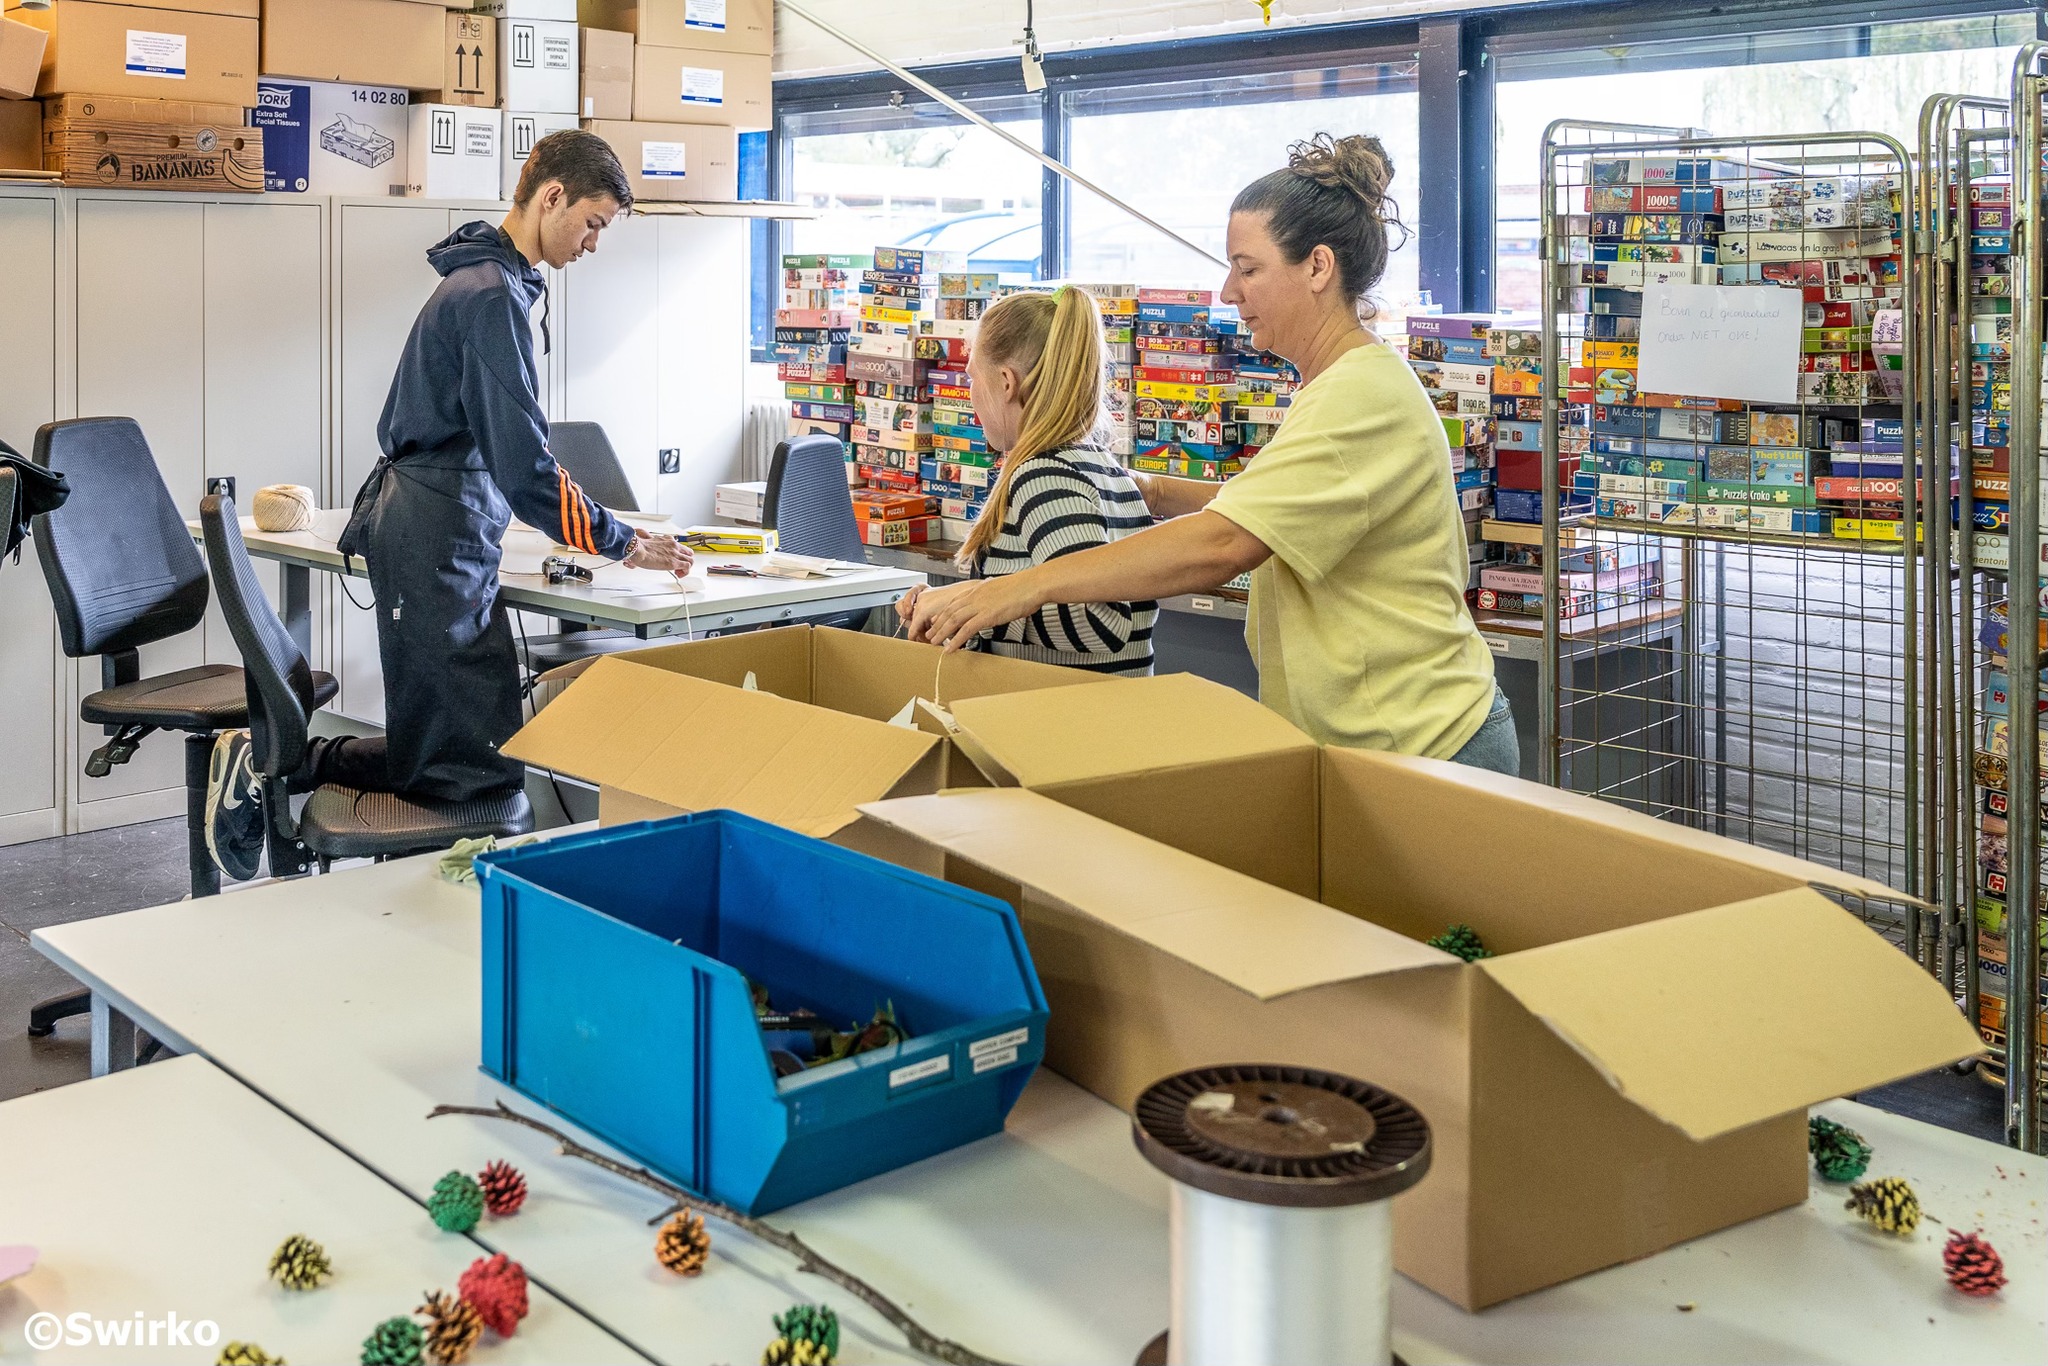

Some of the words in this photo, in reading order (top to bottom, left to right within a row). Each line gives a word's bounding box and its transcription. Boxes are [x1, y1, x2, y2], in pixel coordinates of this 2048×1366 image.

[258, 93, 289, 106] TORK
[352, 90, 367, 102] 14
[371, 91, 386, 104] 02
[391, 93, 406, 105] 80
[256, 110, 273, 118] Extra
[274, 111, 288, 119] Soft
[256, 118, 276, 126] Facial
[276, 119, 300, 127] Tissues
[156, 153, 188, 161] PREMIUM
[132, 159, 215, 181] BANANAS
[1644, 167, 1665, 178] 1000
[1647, 195, 1669, 206] 1000
[1979, 237, 2003, 247] K3
[1813, 243, 1821, 252] la
[1630, 269, 1659, 278] PUZZLE
[1669, 270, 1686, 278] 1000
[1142, 308, 1166, 316] PUZZLE
[1411, 321, 1440, 330] PUZZLE
[776, 331, 794, 341] 1000
[832, 331, 848, 342] 100
[1691, 329, 1721, 341] NIET
[865, 361, 885, 372] 3000
[941, 389, 960, 397] JUMBO
[1463, 399, 1477, 409] 1000
[1478, 400, 1486, 409] PC
[1266, 410, 1283, 420] 900
[1612, 407, 1630, 417] M.C.
[1139, 422, 1153, 431] 1000
[1737, 417, 1747, 441] 1000
[1877, 426, 1903, 435] Puzzl
[853, 429, 867, 437] 1000
[1139, 439, 1152, 447] 1000
[1755, 450, 1785, 459] That's
[1786, 451, 1804, 460] Life
[1135, 459, 1168, 471] L'EUROPE
[890, 481, 908, 489] PUZZLE
[931, 483, 948, 492] 1000
[1870, 482, 1896, 493] 100
[1975, 479, 2009, 490] PUZZ
[1723, 488, 1747, 499] Puzzle
[1750, 490, 1771, 501] Kroko
[887, 507, 906, 516] PUZZLE
[1488, 574, 1520, 584] PANORAMA
[1520, 576, 1540, 585] JIGSAW
[1499, 596, 1523, 609] 1000
[1977, 903, 1993, 911] uzzle
[1982, 931, 2001, 941] Puzzle
[1979, 960, 2007, 976] 1000
